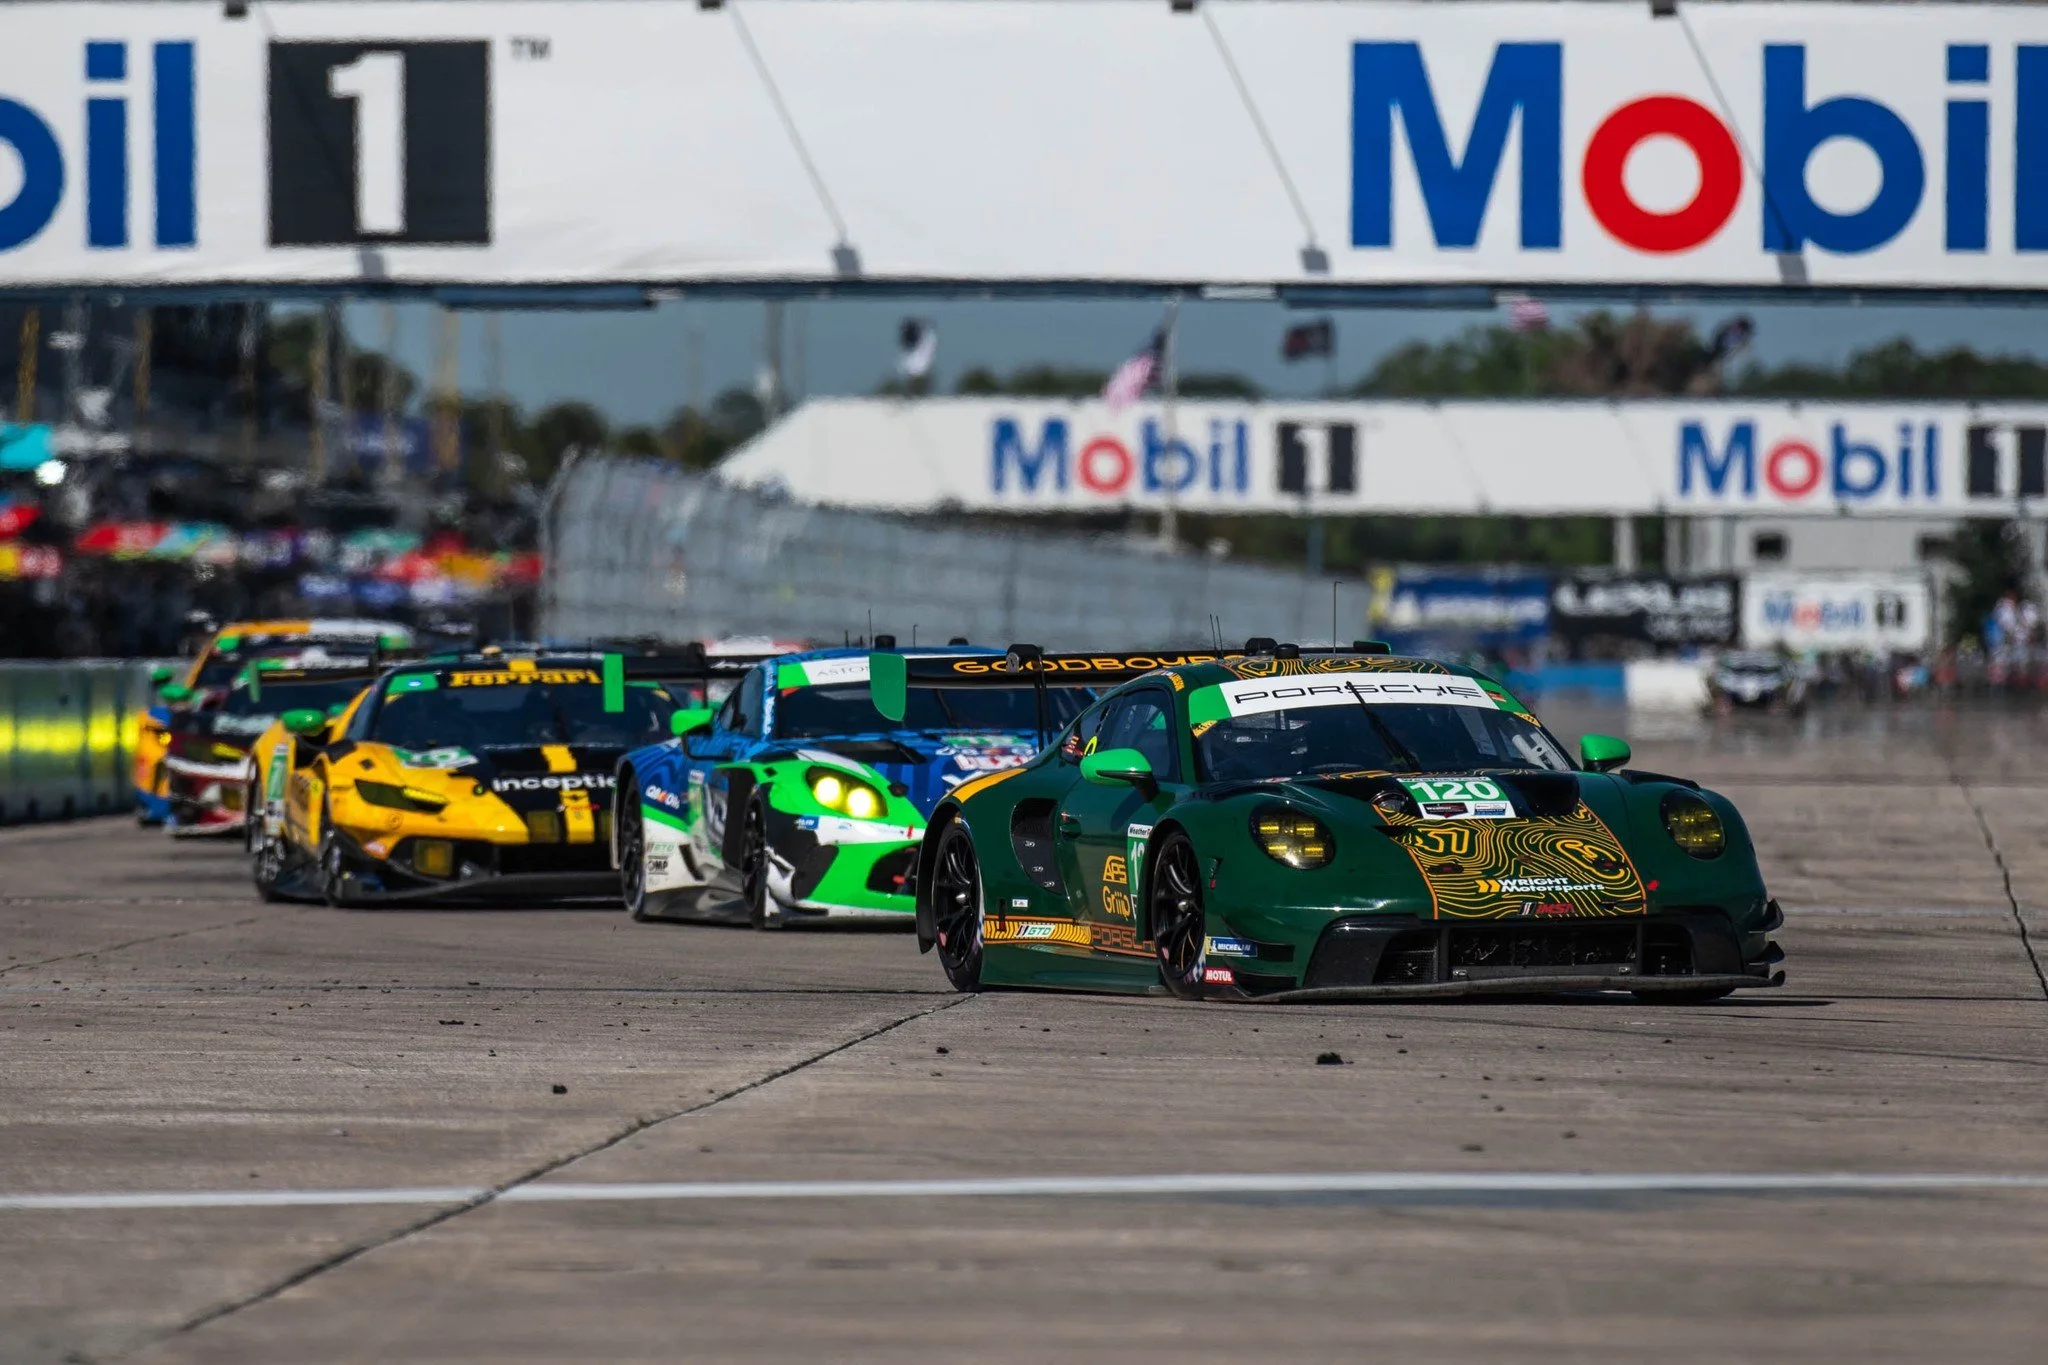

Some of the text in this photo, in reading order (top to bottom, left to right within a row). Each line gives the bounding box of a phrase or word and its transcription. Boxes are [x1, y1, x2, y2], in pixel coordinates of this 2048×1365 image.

[328, 50, 406, 235] 1
[1351, 40, 2048, 256] Mobil
[991, 416, 1331, 494] Mobil 1
[1680, 421, 2020, 499] Mobil 1
[1234, 684, 1482, 704] PORSCHE
[1410, 781, 1500, 800] 120
[1498, 878, 1568, 886] WRIGHT
[1500, 883, 1605, 893] Motorsports
[1028, 926, 1052, 936] GTD
[1217, 943, 1251, 951] MICHELIN
[1205, 969, 1233, 982] MOTUL
